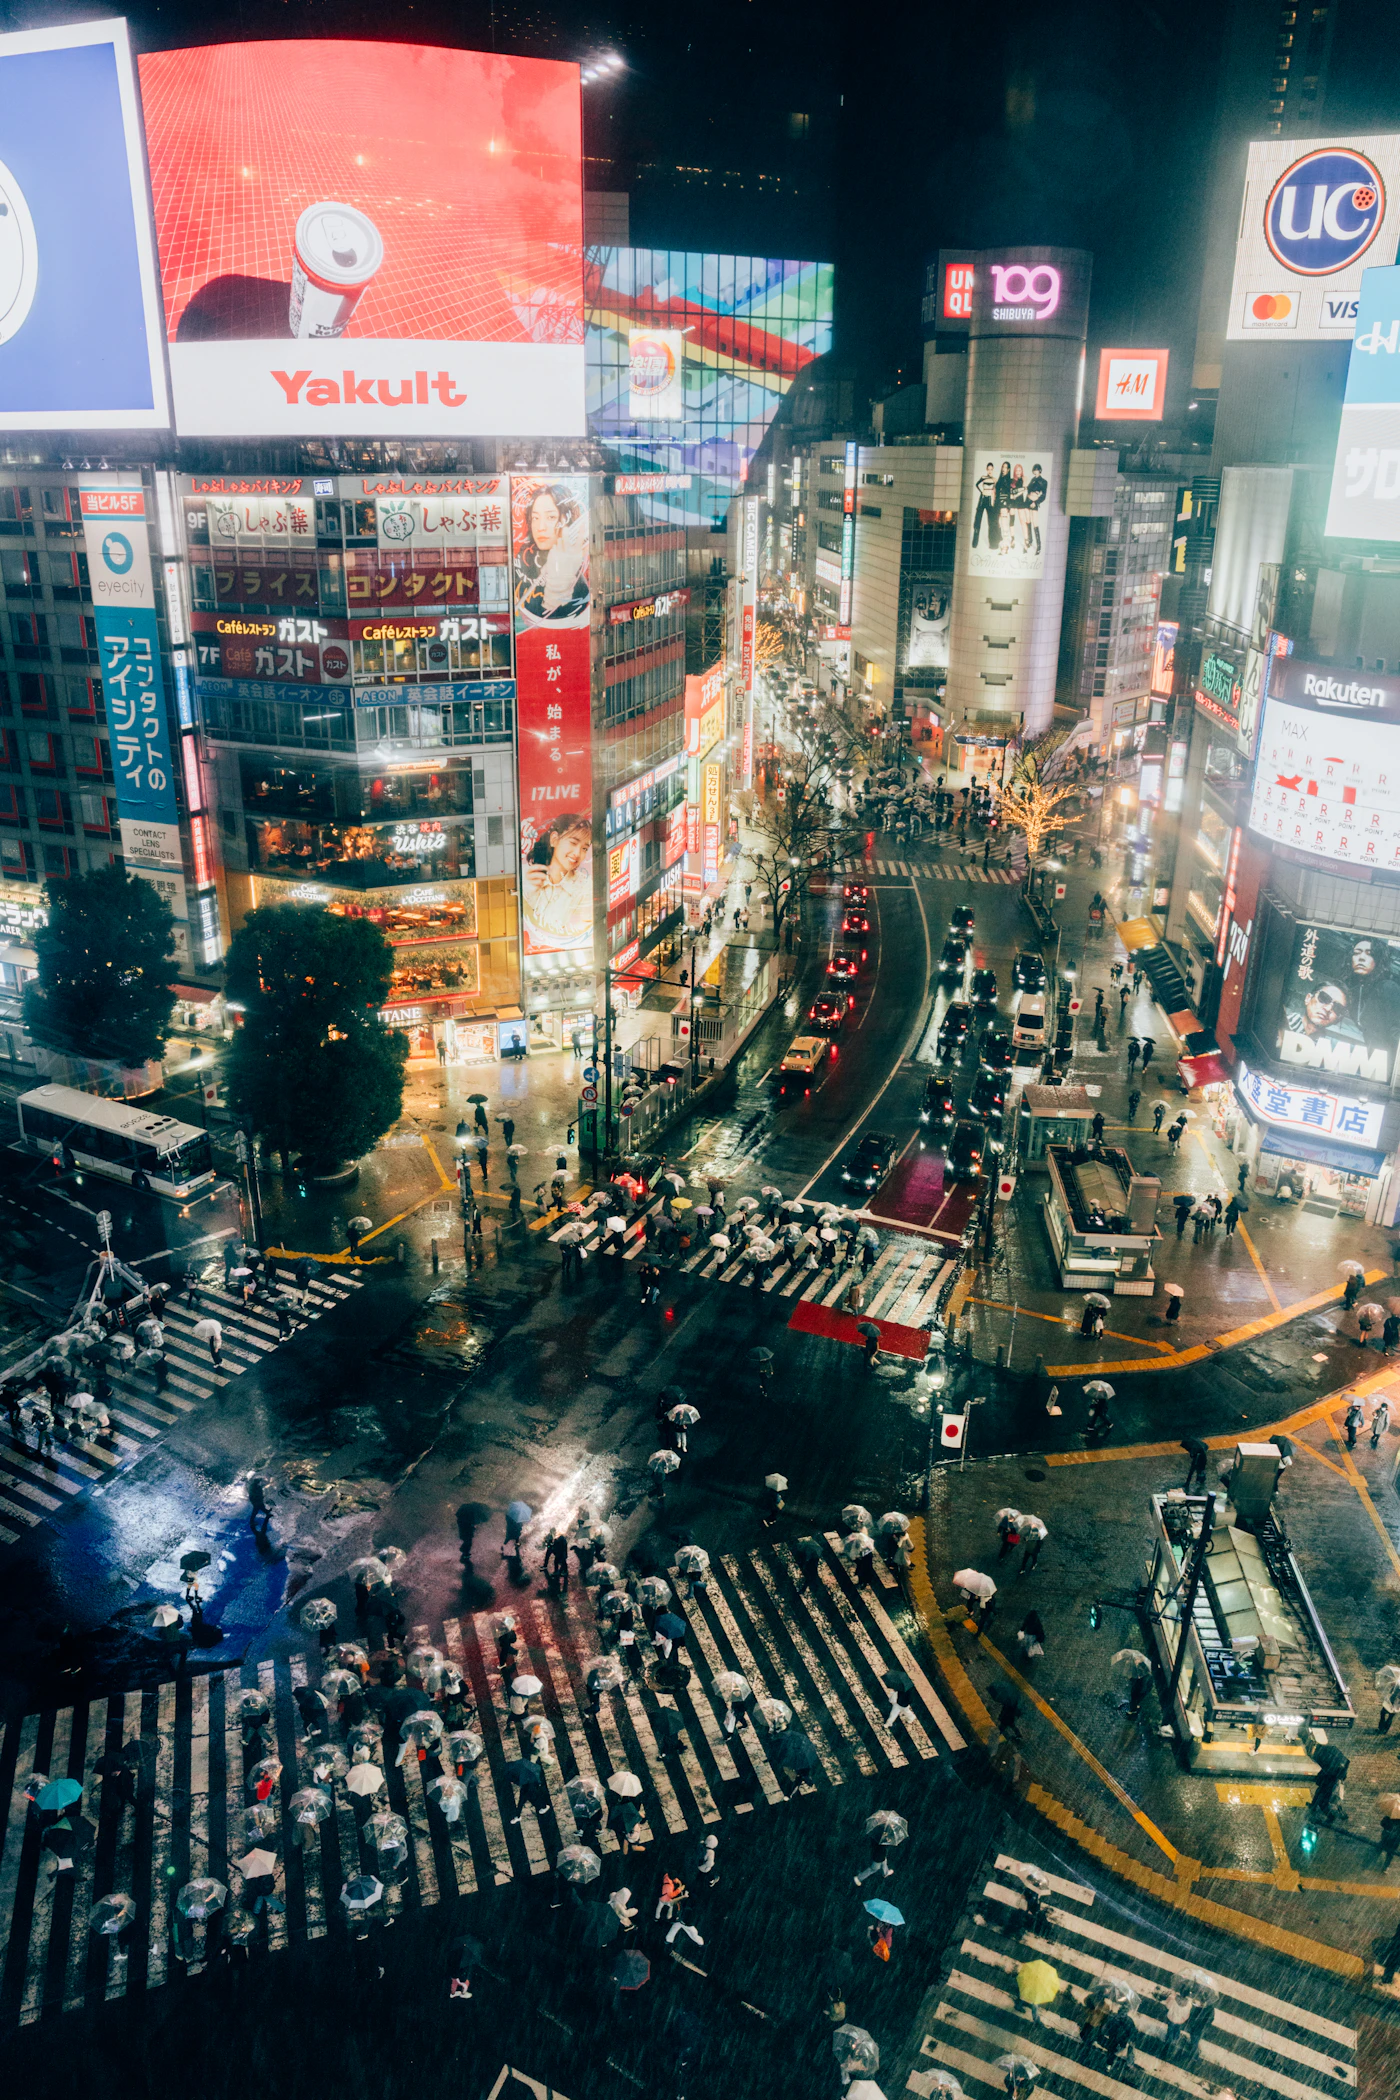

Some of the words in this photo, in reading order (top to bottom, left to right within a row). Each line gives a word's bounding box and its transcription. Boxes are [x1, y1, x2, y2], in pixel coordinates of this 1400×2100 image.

[991, 265, 1060, 320] 109
[993, 309, 1034, 320] SHIBUYA
[270, 371, 467, 407] Yakult
[1115, 373, 1149, 395] H&M
[191, 478, 302, 494] しゃぶしゃぶバイキング
[362, 479, 501, 494] しゃぶしゃぶバイキング
[87, 494, 137, 511] 当ビル5F
[747, 501, 756, 521] BIC
[188, 511, 206, 529] 9F
[245, 507, 309, 535] しゃぶ葉
[423, 504, 502, 533] しゃぶ葉
[745, 523, 755, 572] CAMERA
[98, 580, 145, 598] eyecity
[217, 571, 315, 597] プライス
[348, 571, 474, 598] コンタクト
[655, 595, 672, 617] ガスト
[278, 617, 328, 644] ガスト
[440, 617, 497, 642] ガスト
[199, 646, 221, 665] 7F
[255, 646, 314, 677] ガスト
[326, 659, 347, 669] ガスト
[202, 680, 228, 693] AEON
[237, 682, 324, 702] 英会話イーオン
[362, 689, 397, 702] AEON
[407, 683, 513, 703] 英会話イーオン
[1304, 673, 1385, 708] Rakuten
[103, 636, 143, 788] アイシティ
[134, 637, 166, 790] コンタクトの
[545, 644, 562, 774] 私が、始まる。
[1281, 720, 1309, 741] MAX
[531, 784, 581, 801] 17LIVE
[707, 766, 719, 806] 処方せん
[1321, 803, 1328, 815] R
[1344, 809, 1352, 821] R
[1315, 817, 1331, 825] POINT
[1339, 823, 1356, 831] POINT
[1372, 814, 1380, 826] R
[133, 827, 167, 840] CONTACT
[1317, 831, 1324, 842] R
[1365, 828, 1384, 836] POINT
[141, 838, 160, 848] LENS
[391, 833, 447, 853] Ushi8
[1340, 836, 1348, 848] R
[1366, 842, 1375, 854] R
[129, 846, 175, 860] SPECIALISTS
[1334, 850, 1351, 858] POINT
[1360, 855, 1379, 864] POINT
[660, 862, 681, 895] LUSH
[402, 893, 446, 905] L'OCCITANE
[413, 887, 434, 897] CAFÉ
[1298, 928, 1319, 982] 外道の歌
[1280, 1030, 1388, 1081] DMM
